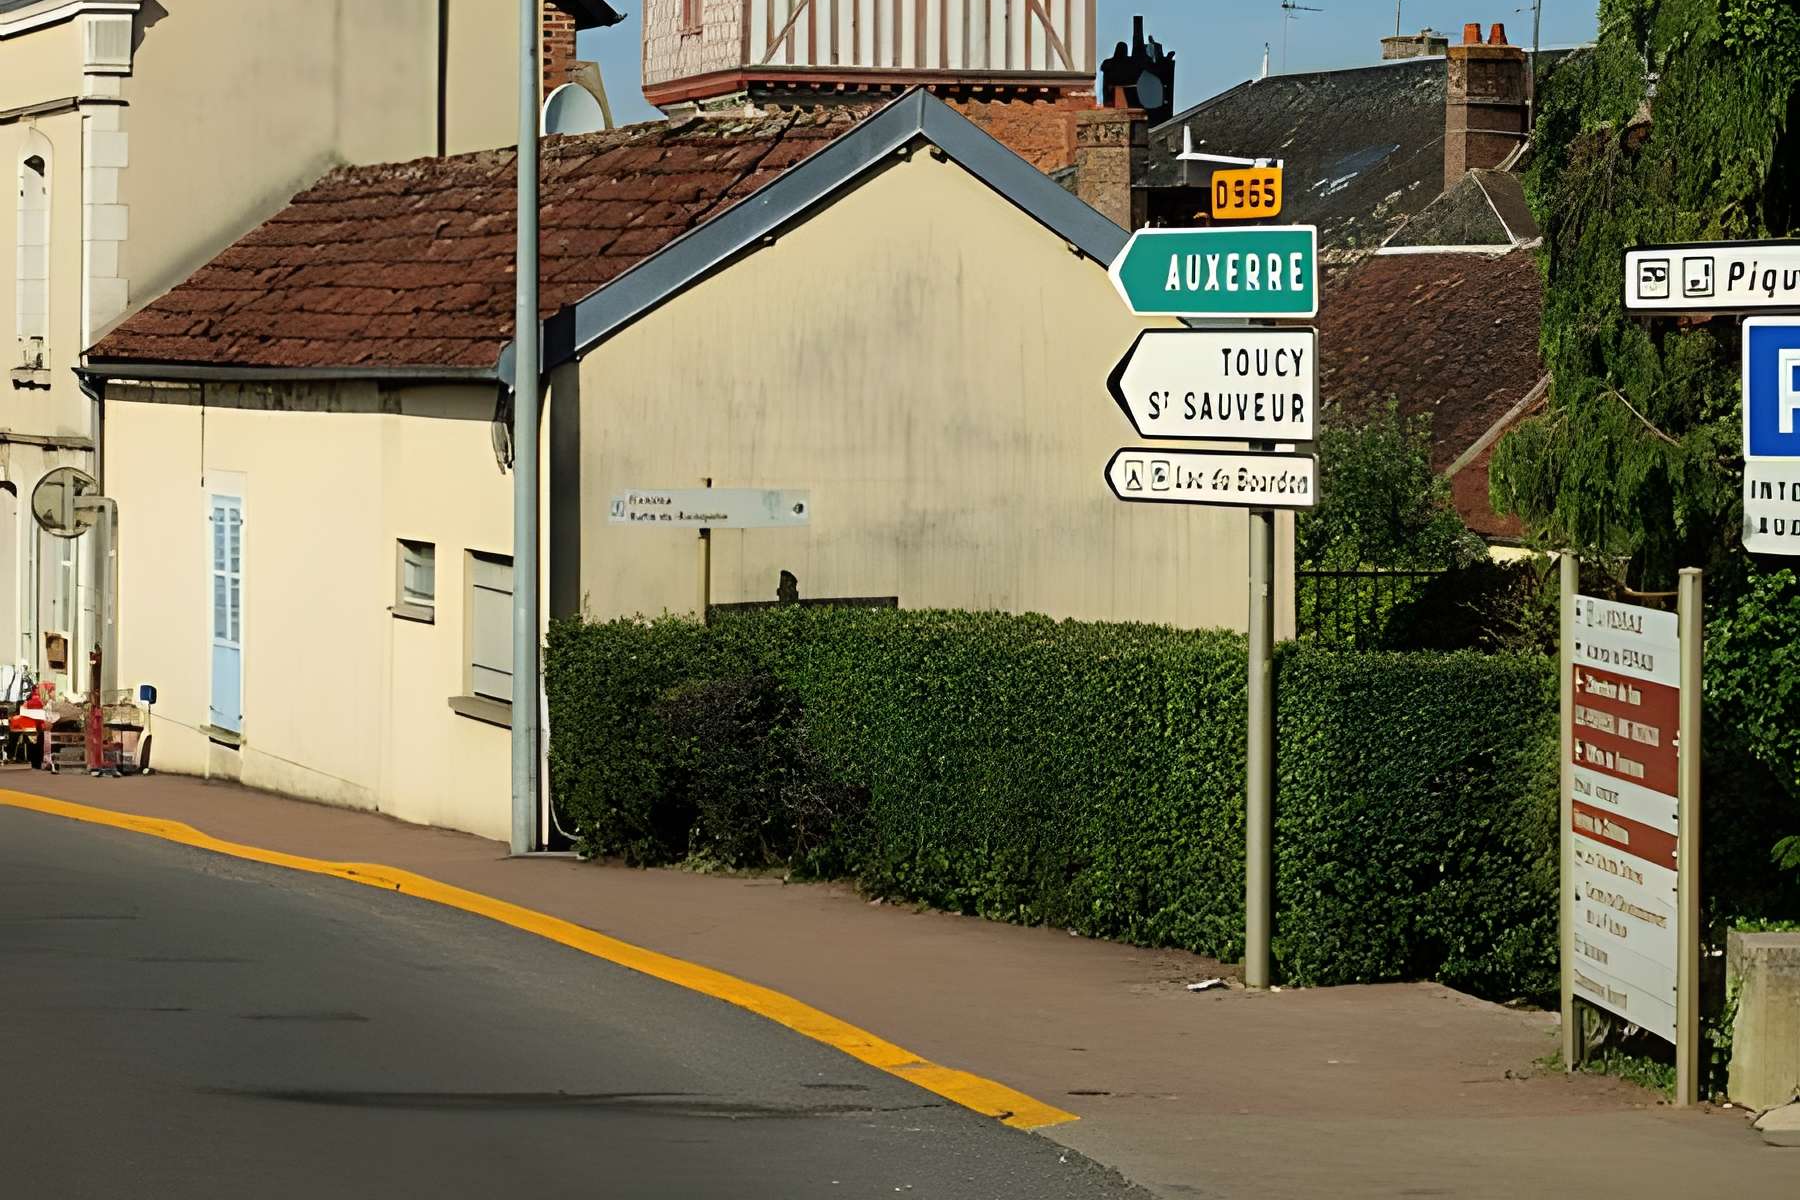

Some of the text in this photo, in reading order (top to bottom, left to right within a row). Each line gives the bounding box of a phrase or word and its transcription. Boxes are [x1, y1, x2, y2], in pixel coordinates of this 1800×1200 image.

[1164, 252, 1305, 292] AUXERRE
[1727, 260, 1800, 298] Piqu
[1221, 348, 1304, 377] TOUCY
[1184, 392, 1304, 422] SAUVEUR
